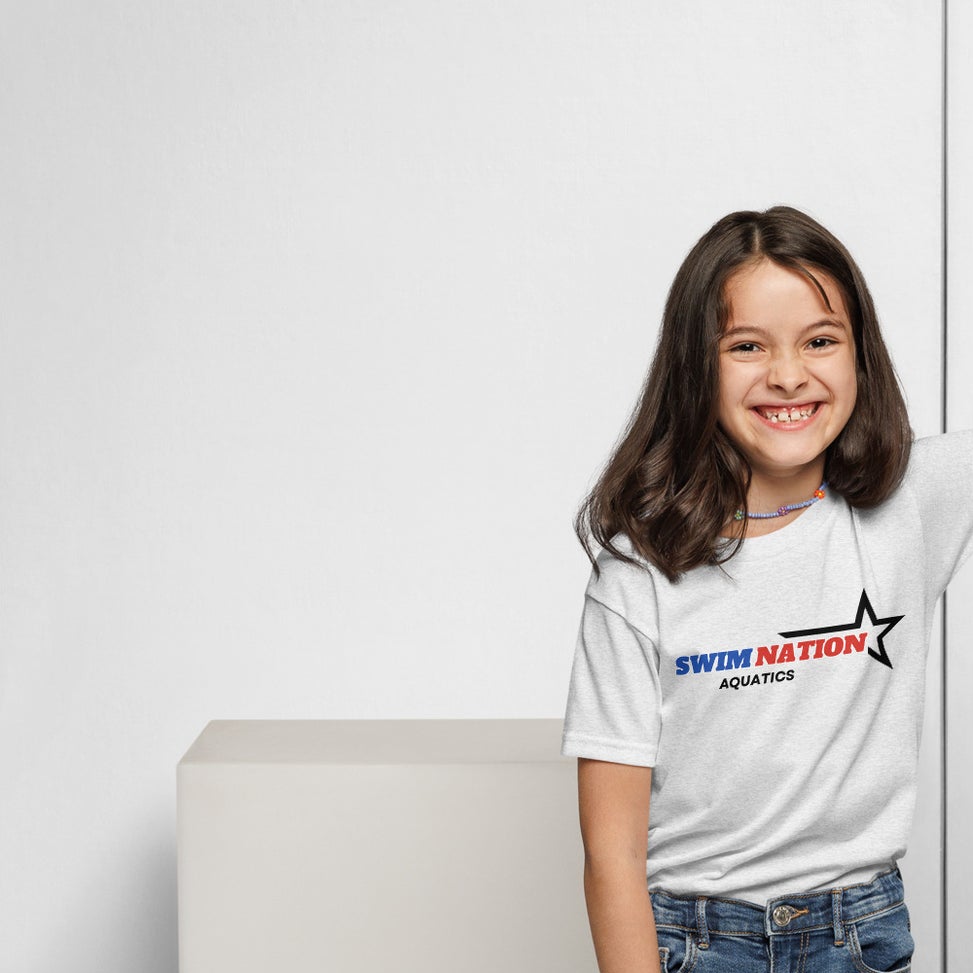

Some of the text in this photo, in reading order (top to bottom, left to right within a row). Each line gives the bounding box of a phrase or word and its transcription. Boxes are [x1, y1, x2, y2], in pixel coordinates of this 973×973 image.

[675, 632, 869, 676] SWIM NATION
[719, 669, 795, 690] AQUATICS
